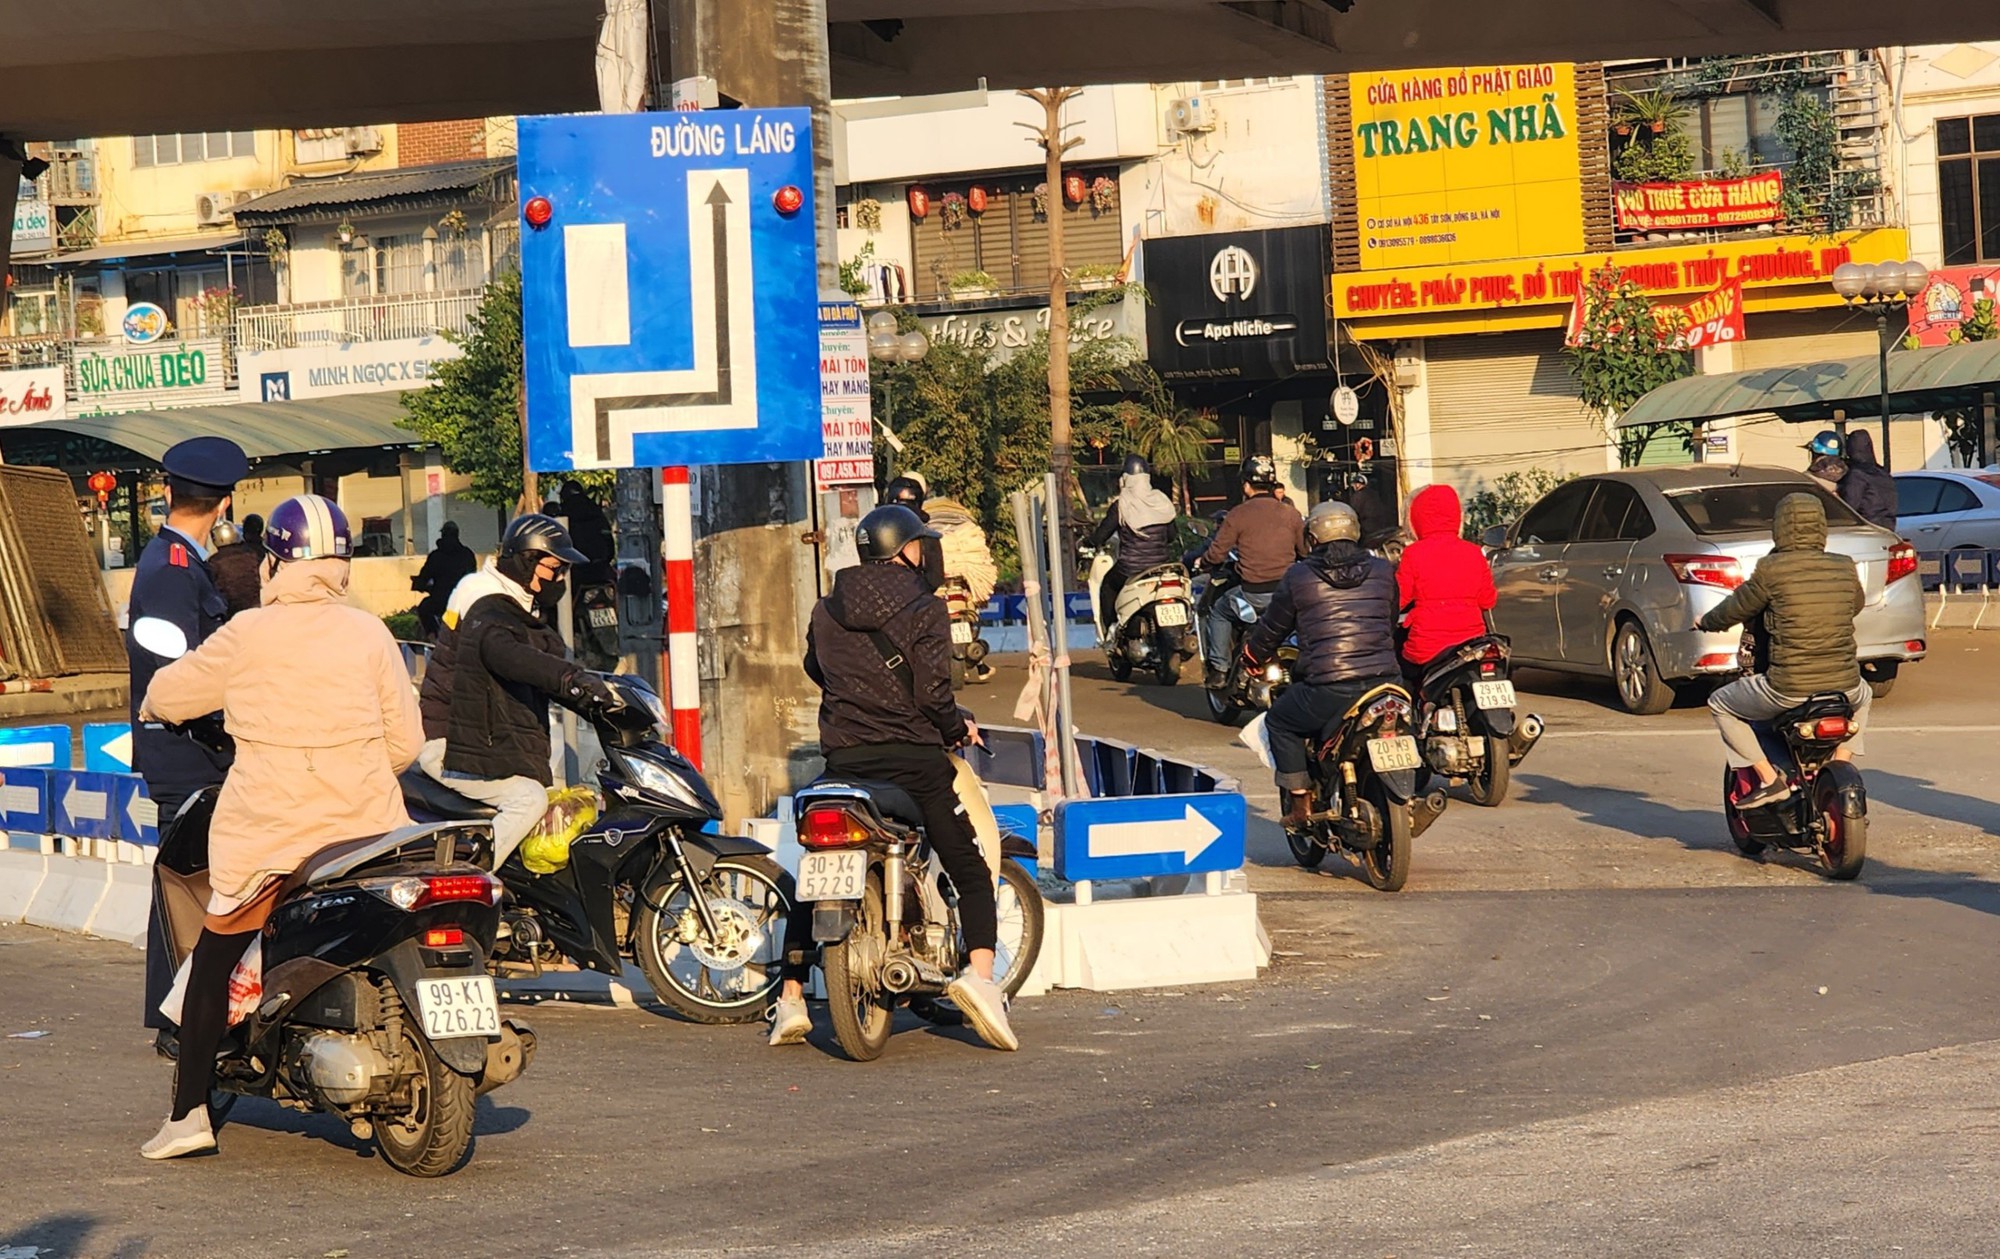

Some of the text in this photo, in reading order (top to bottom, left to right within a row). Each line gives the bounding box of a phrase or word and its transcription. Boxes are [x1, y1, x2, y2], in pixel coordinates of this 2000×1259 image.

[1367, 64, 1553, 105] CỬA HÀNG ĐỒ PHẬT GIÁO
[651, 115, 796, 157] ĐƯỜNG LÁNG
[1357, 92, 1565, 158] TRANG NHÃ
[1646, 185, 1686, 211] THUÊ
[1688, 181, 1724, 208] CỬA
[1727, 179, 1780, 206] HÀNG
[1413, 213, 1429, 225] 436
[1347, 277, 1417, 312] CHUYÊN:
[1420, 273, 1467, 307] PHÁP
[1470, 274, 1521, 308] PHỤC,
[1523, 262, 1547, 299] ĐỒ
[1001, 316, 1029, 348] &
[1203, 319, 1273, 341] Apa Niche
[80, 342, 206, 393] SỮA CHUA DẺO
[309, 366, 349, 387] MINH
[353, 361, 397, 386] NGỌC
[399, 361, 411, 381] X
[845, 355, 866, 374] TÔN
[848, 418, 871, 437] TÔN
[846, 437, 873, 457] MÁNG
[1479, 683, 1507, 695] 29-H1
[1375, 739, 1410, 755] 20-M9
[1379, 753, 1413, 769] 1508
[807, 854, 855, 875] 30-X4
[806, 875, 854, 897] 5229
[430, 981, 484, 1006] 99-K1
[429, 1006, 496, 1034] 226.23
